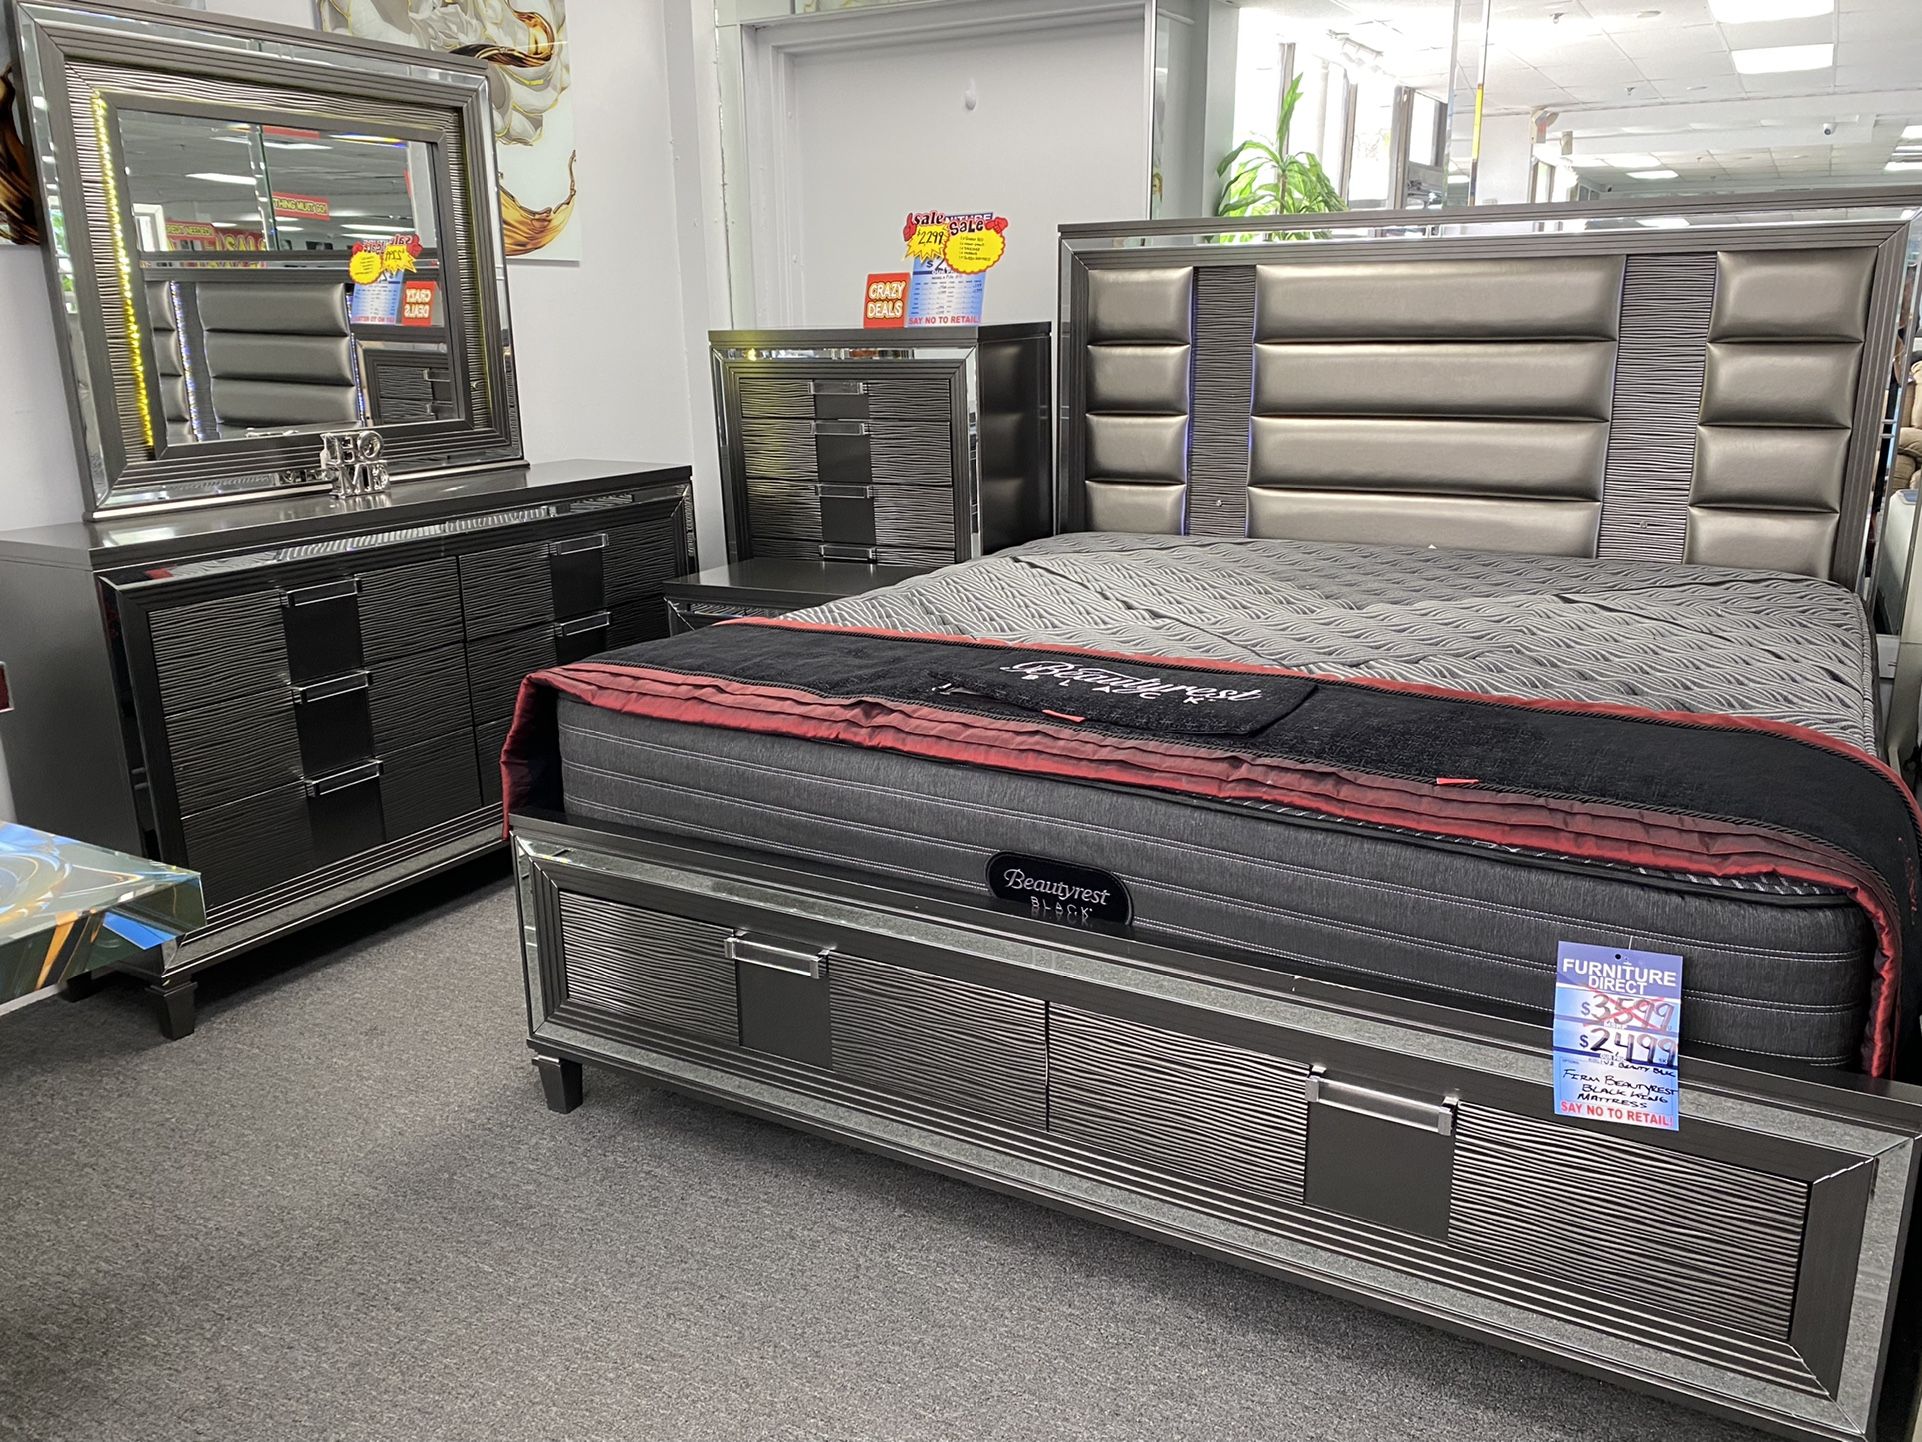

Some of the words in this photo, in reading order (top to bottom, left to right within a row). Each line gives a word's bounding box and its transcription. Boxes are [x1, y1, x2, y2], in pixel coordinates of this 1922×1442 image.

[913, 211, 944, 225] sale
[868, 282, 905, 299] CRAZY
[867, 301, 903, 318] DEALS
[908, 317, 924, 325] SAY
[925, 316, 937, 324] NO
[938, 316, 948, 324] TO
[1000, 660, 1264, 702] Beautyrest
[1004, 868, 1111, 906] Beautyrest
[1563, 958, 1677, 986] FURNITURE
[1588, 976, 1647, 995] DIRECT
[1604, 1075, 1679, 1097] BEAUTYREST
[1577, 1092, 1648, 1109] MATTRESS
[1561, 1101, 1583, 1115] SAY
[1586, 1104, 1604, 1118] NO
[1607, 1107, 1623, 1120] TO
